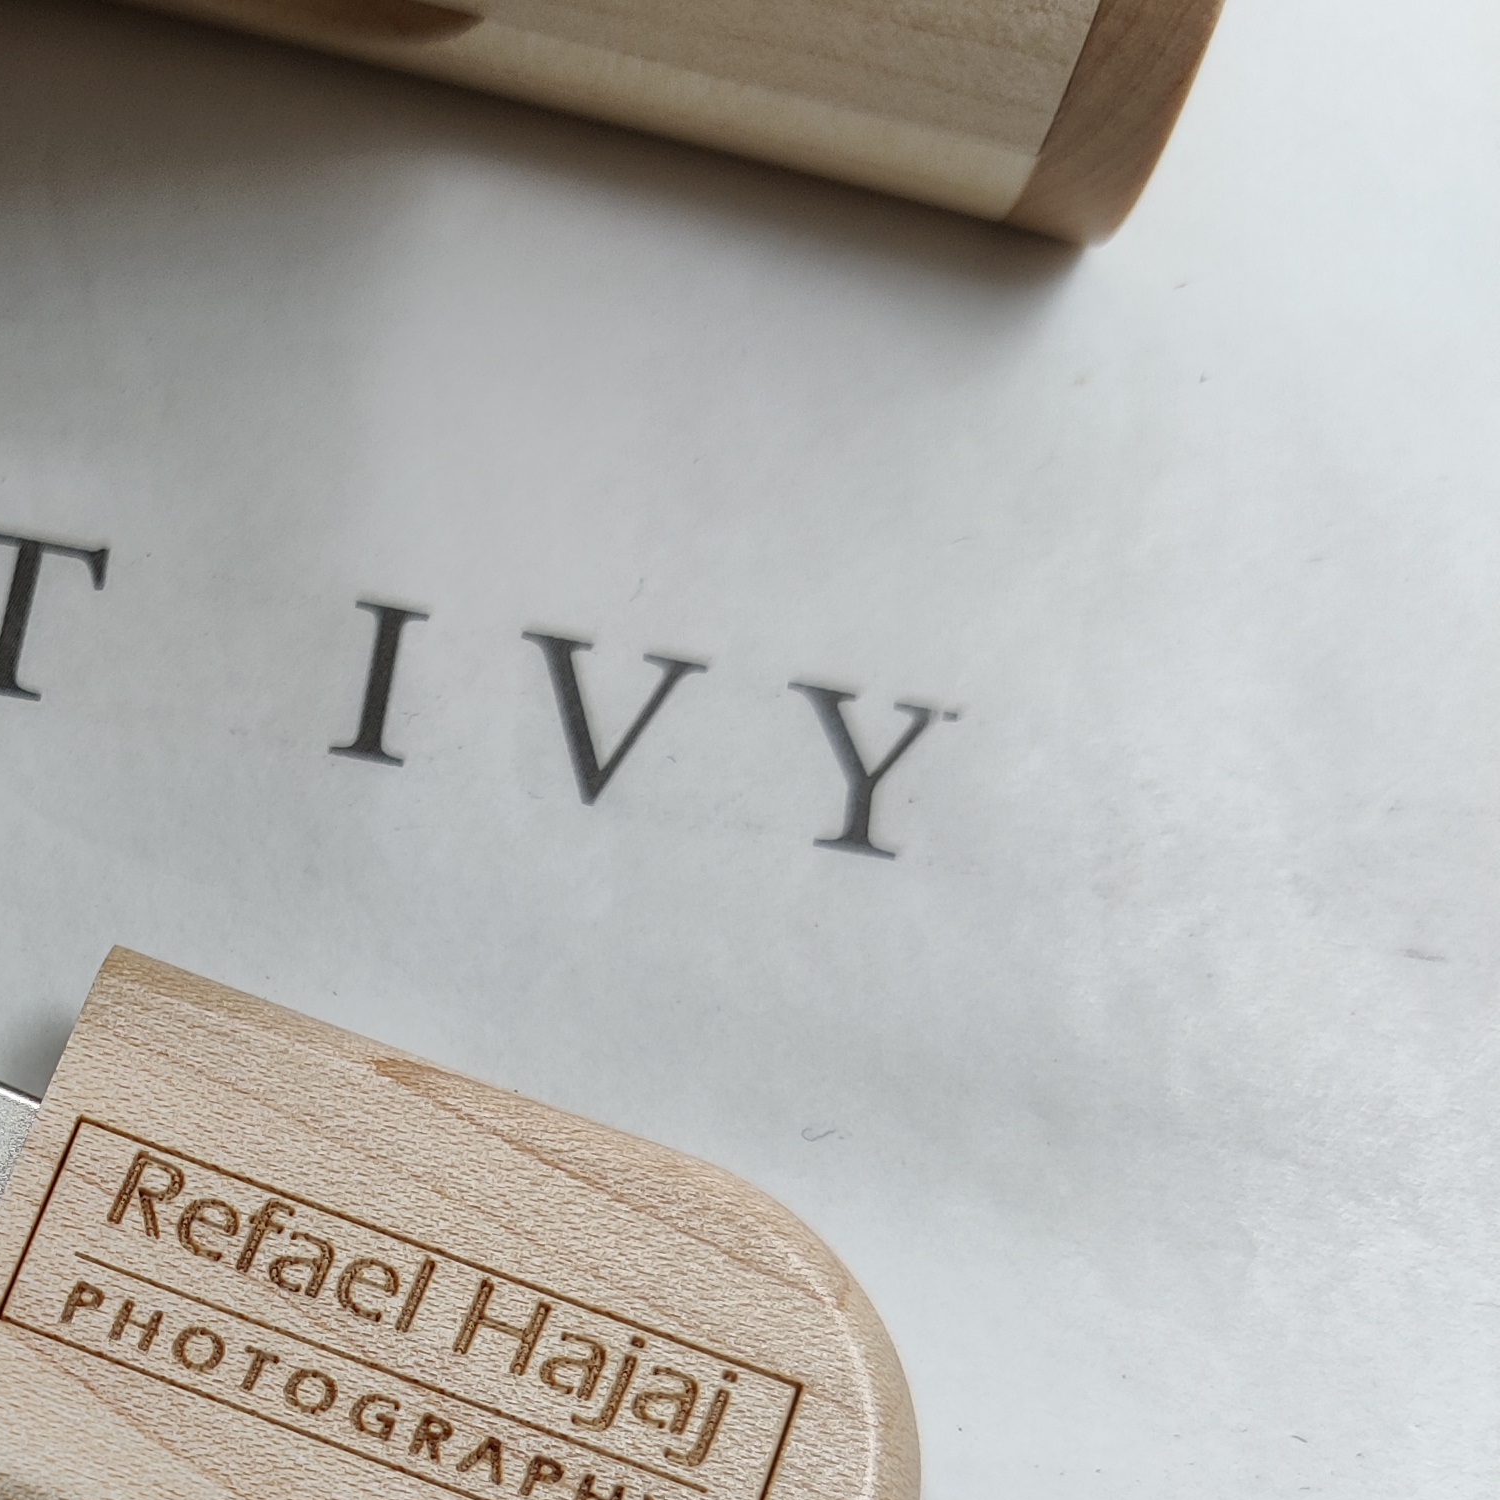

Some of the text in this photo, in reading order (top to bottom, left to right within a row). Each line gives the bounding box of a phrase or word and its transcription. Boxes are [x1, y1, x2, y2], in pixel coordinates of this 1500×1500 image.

[328, 600, 958, 861] IVY
[106, 1149, 741, 1467] Refael Hajaj
